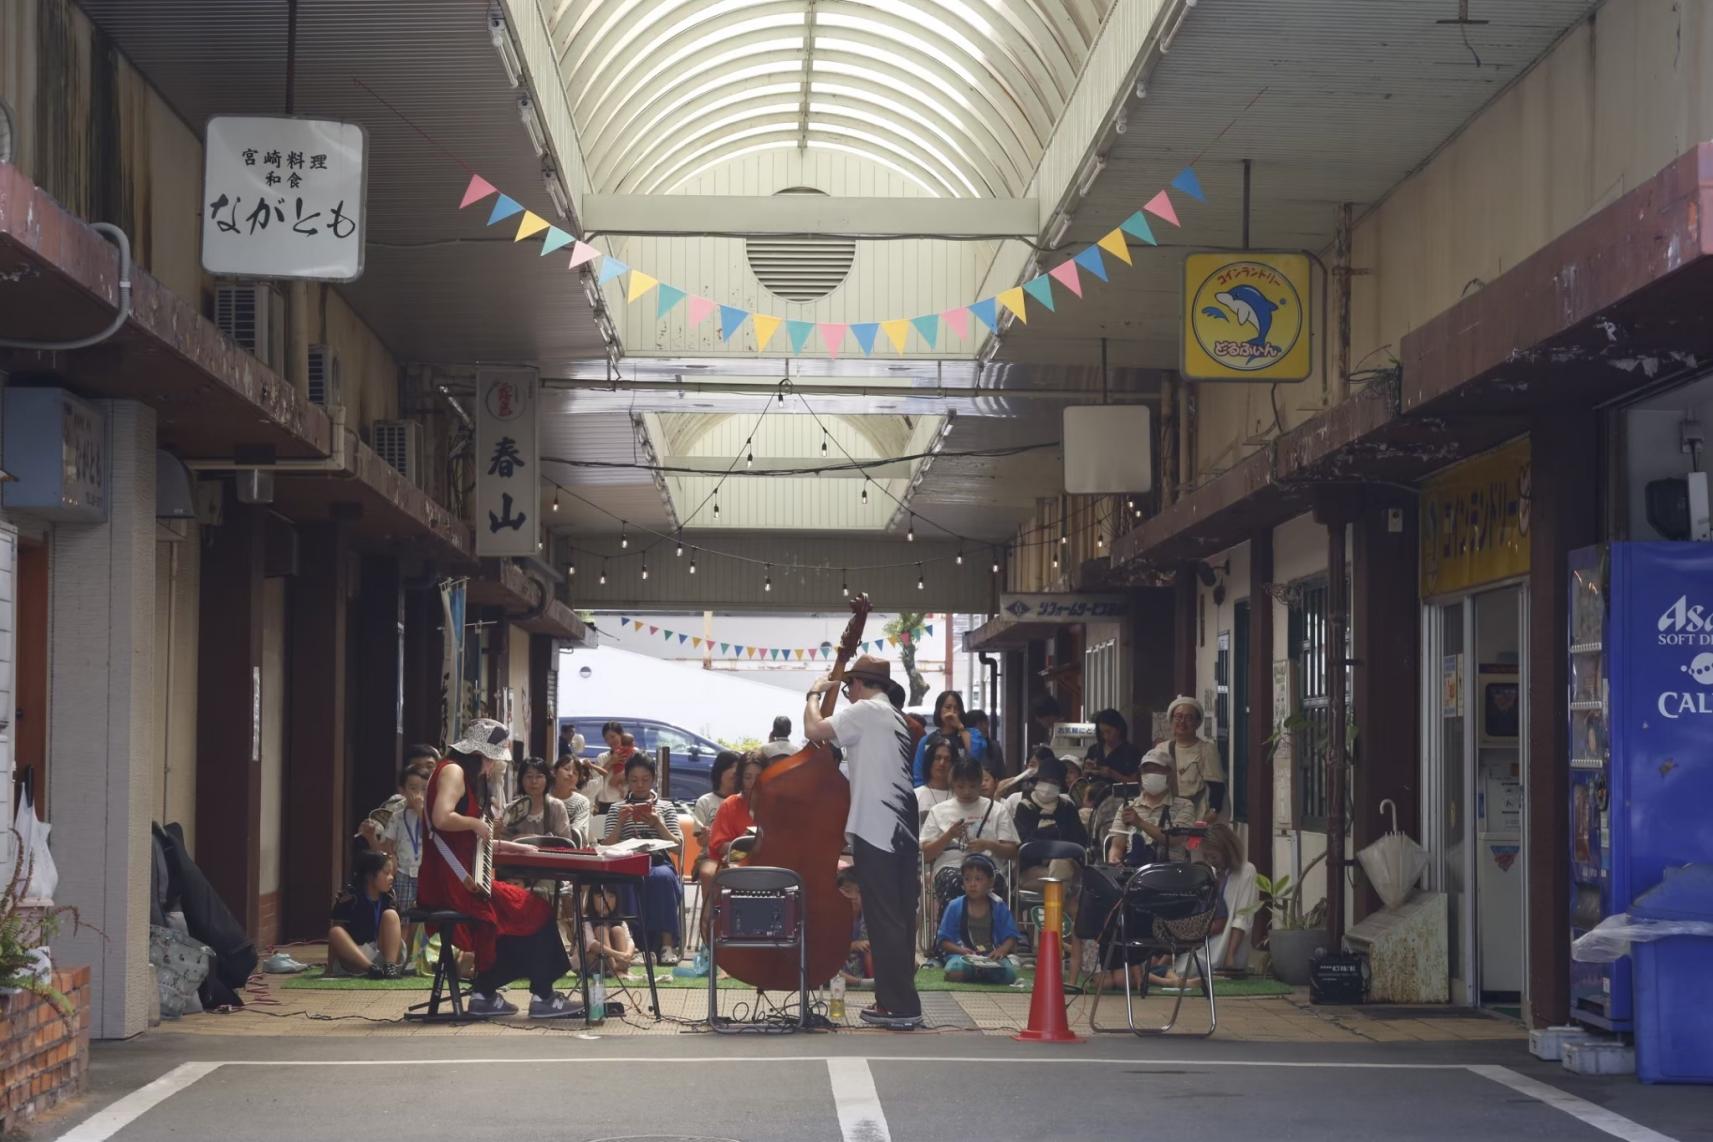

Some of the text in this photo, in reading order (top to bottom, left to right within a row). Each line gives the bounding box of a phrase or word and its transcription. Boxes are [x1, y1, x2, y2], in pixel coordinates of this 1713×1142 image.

[242, 149, 328, 170] 宮崎料理
[265, 171, 303, 189] 和食
[210, 193, 356, 239] ながとも
[487, 436, 527, 534] 春山
[1658, 633, 1696, 646] SOFT
